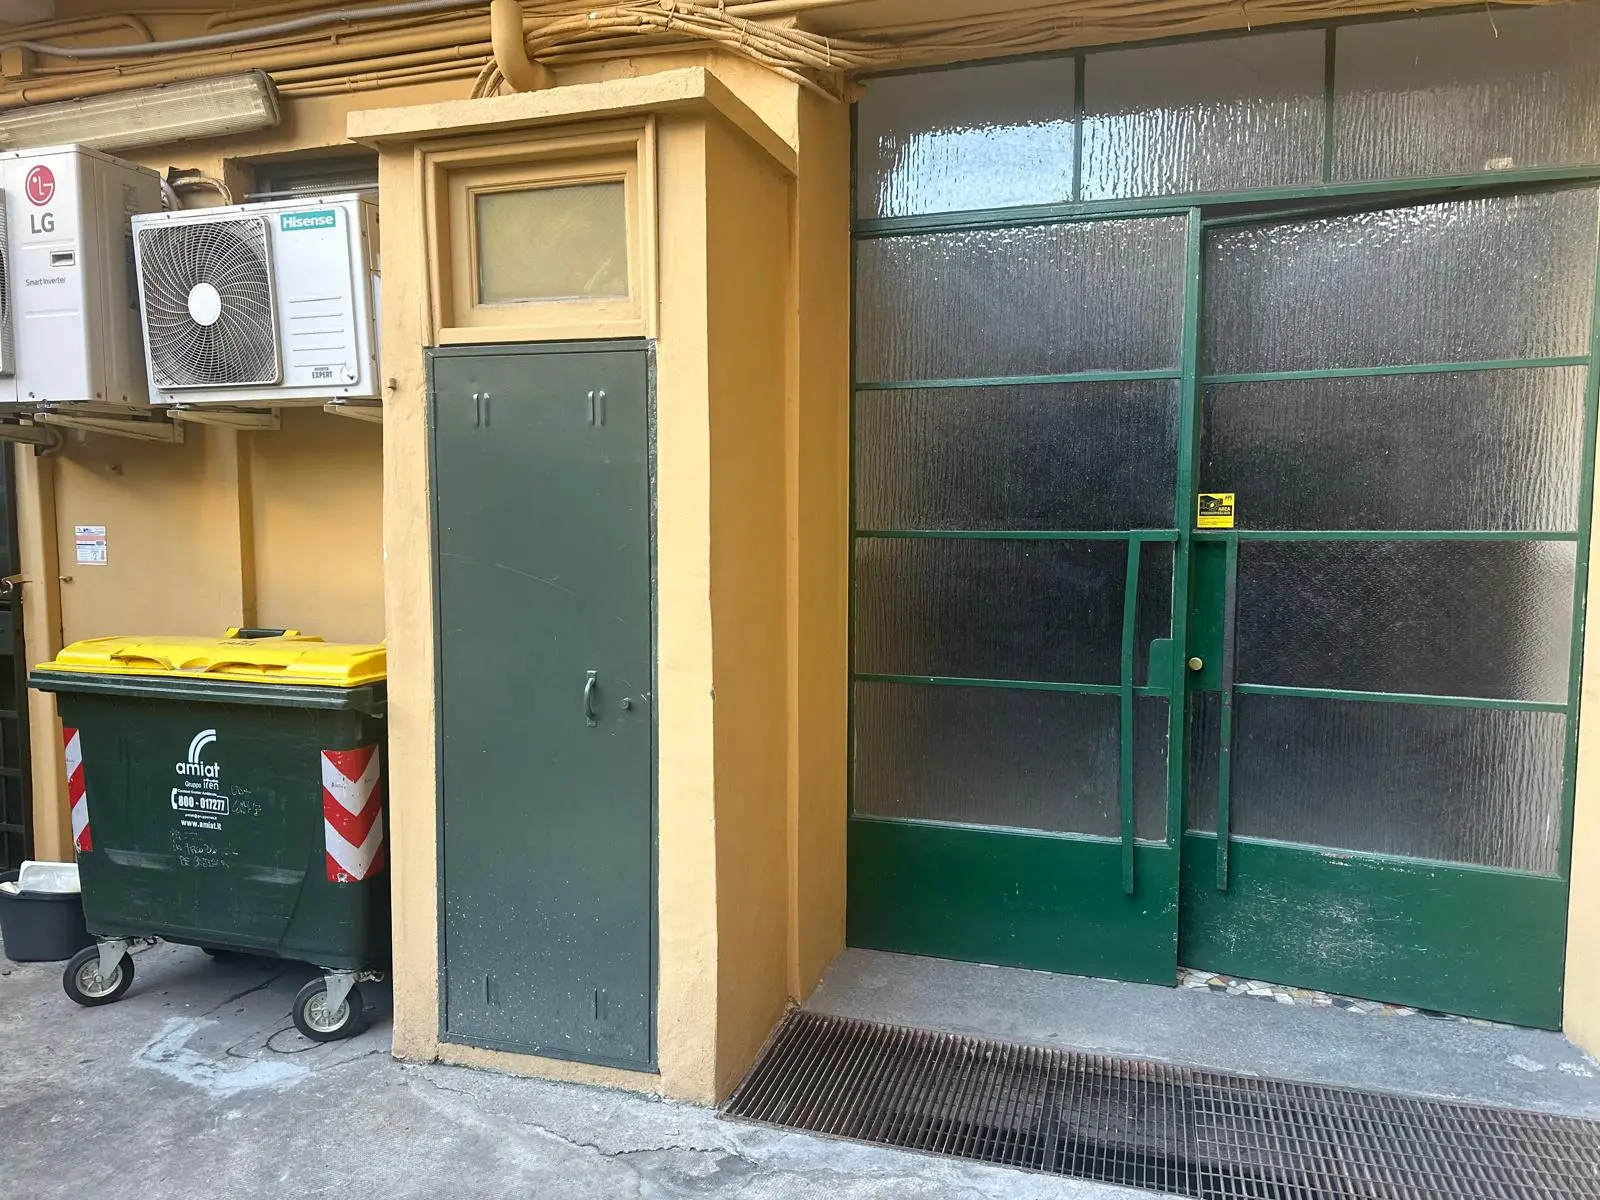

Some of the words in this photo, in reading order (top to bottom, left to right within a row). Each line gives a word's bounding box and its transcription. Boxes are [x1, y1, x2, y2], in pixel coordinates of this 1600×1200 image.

[30, 212, 55, 234] LG
[282, 215, 334, 229] Hisense
[25, 278, 42, 286] Smart
[42, 276, 66, 285] Inverter
[312, 371, 333, 379] EXPERT
[175, 761, 220, 777] amiat
[184, 781, 202, 789] Gruppo
[178, 795, 194, 808] 800
[200, 797, 225, 811] 017277
[180, 820, 222, 831] www.amiat.it
